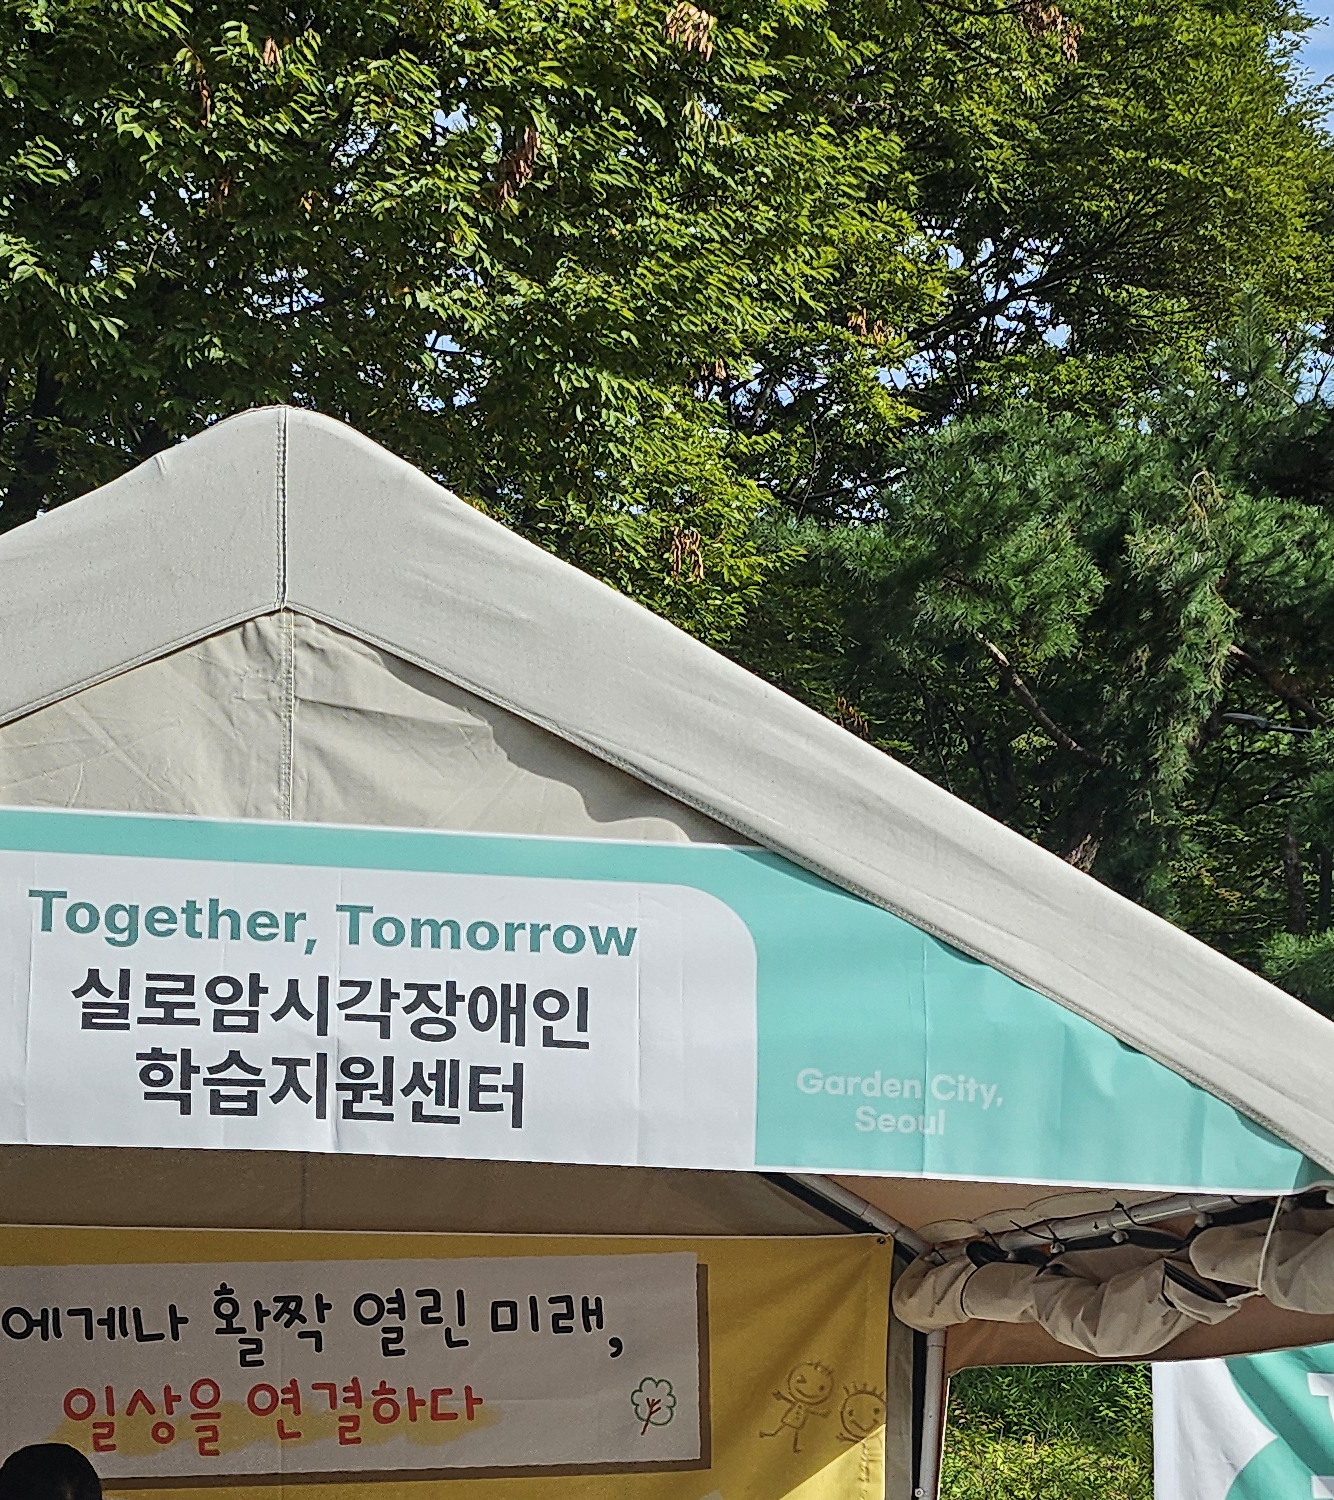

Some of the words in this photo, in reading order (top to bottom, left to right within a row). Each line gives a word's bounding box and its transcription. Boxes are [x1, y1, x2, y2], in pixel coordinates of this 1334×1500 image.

[29, 888, 318, 956] Together,
[335, 903, 637, 958] Tomorrow
[70, 965, 591, 1050] 실로암시각장애인
[135, 1046, 525, 1129] 학습지원센터
[795, 1066, 923, 1100] Garden
[929, 1075, 1003, 1108] City,
[854, 1104, 947, 1136] Seoul
[213, 1282, 332, 1368] 활짝
[352, 1287, 469, 1358] 열린
[491, 1293, 625, 1360] 미래,
[63, 1378, 222, 1457] 일상을
[246, 1377, 484, 1446] 연결하다
